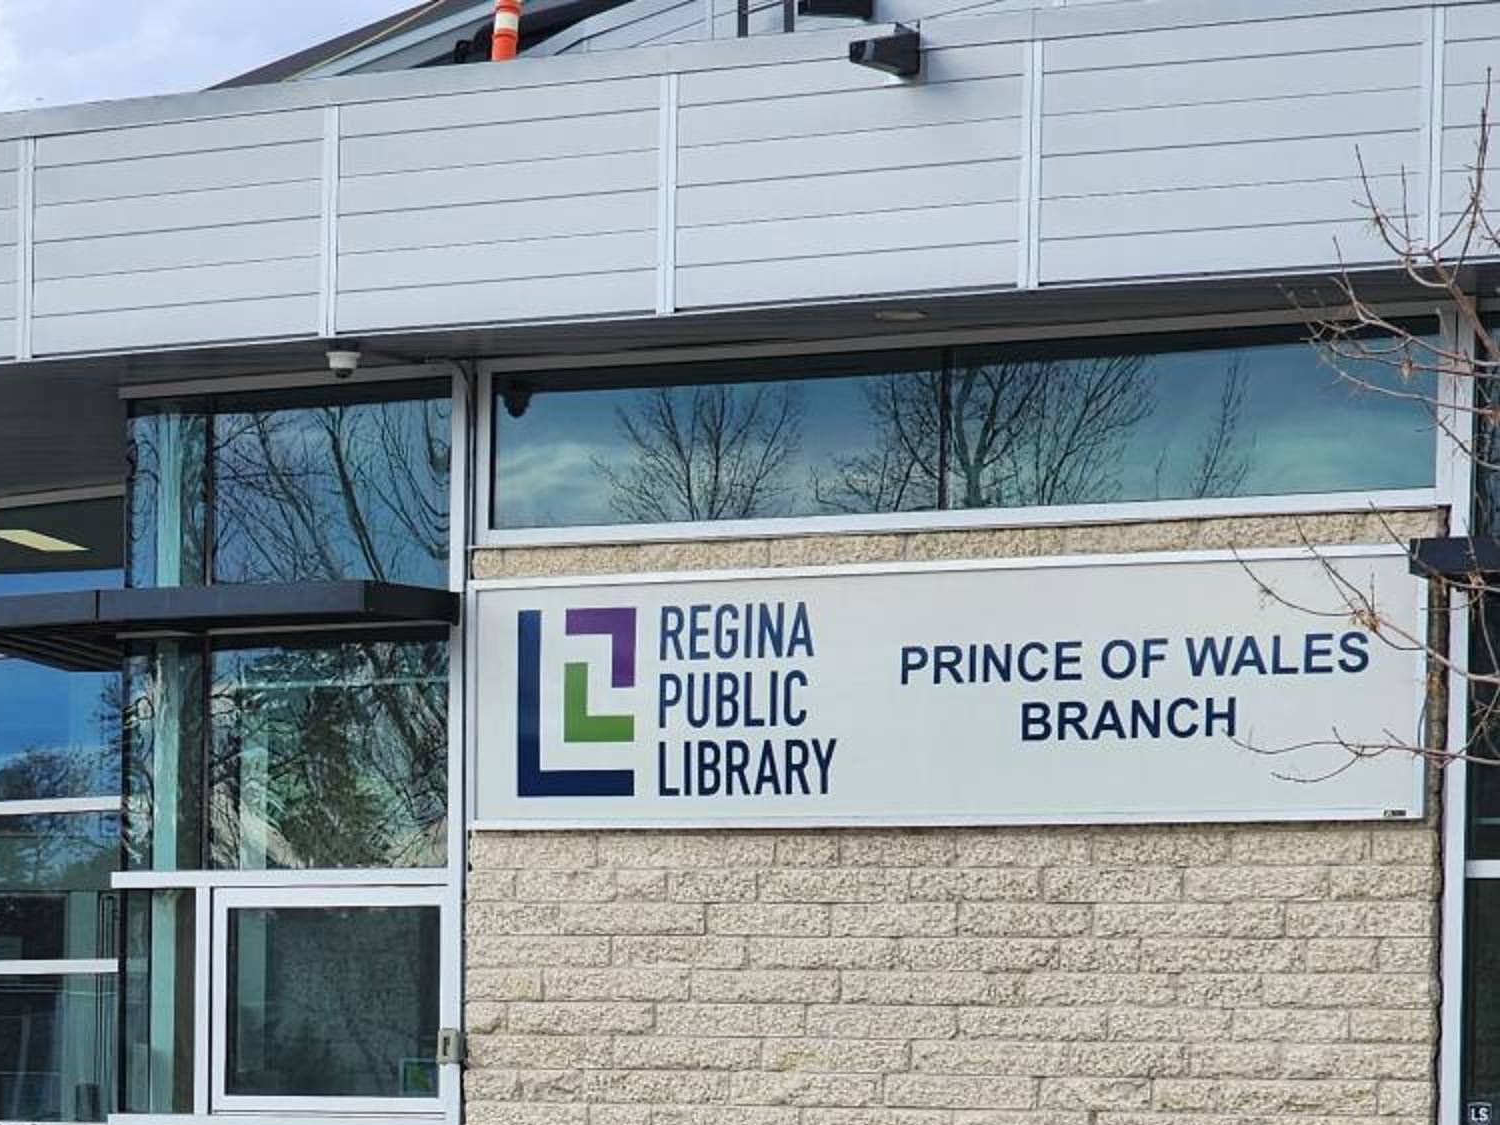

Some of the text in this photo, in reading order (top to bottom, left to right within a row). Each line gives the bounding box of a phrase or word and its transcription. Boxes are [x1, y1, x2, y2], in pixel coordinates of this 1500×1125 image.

[659, 601, 815, 661] REGINA
[901, 631, 1369, 685] PRINCE OF WALES
[658, 669, 808, 729] PUBLIC
[1021, 696, 1237, 742] BRANCH
[658, 738, 837, 797] LIBRARY
[1471, 1107, 1489, 1121] LS
